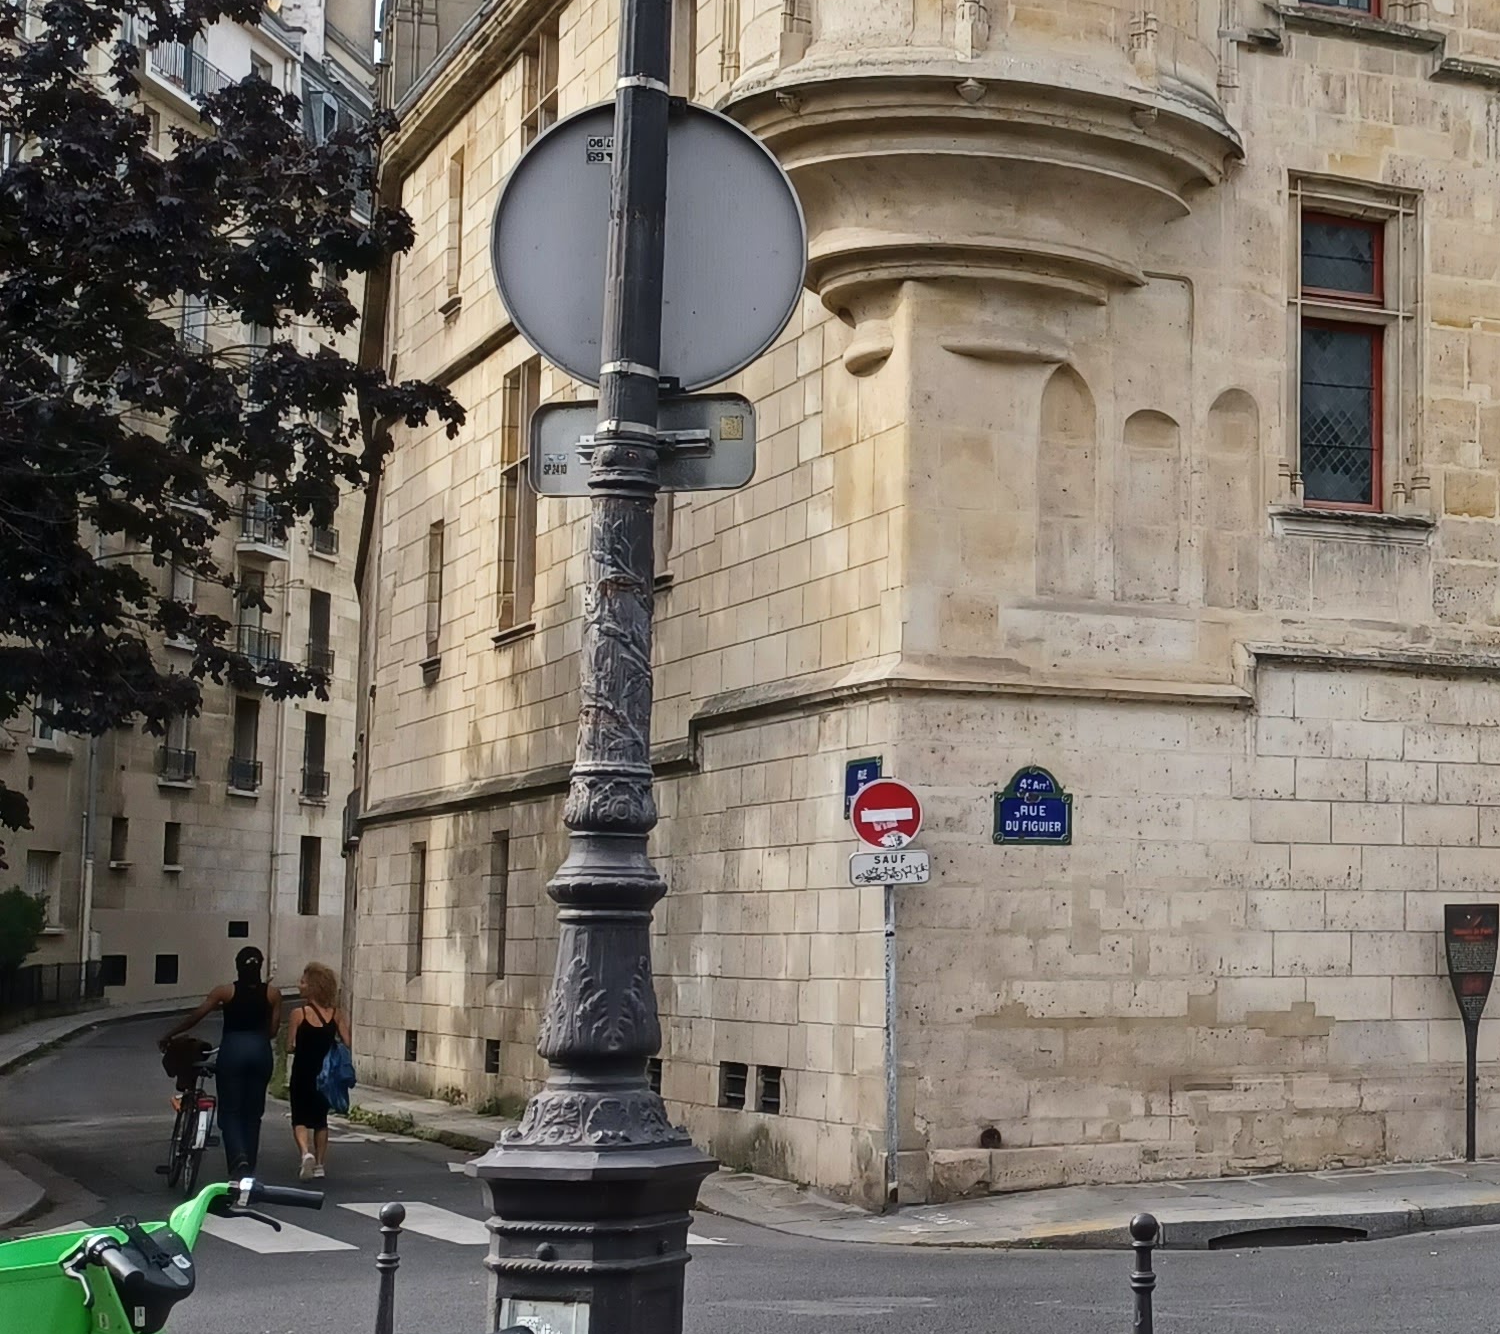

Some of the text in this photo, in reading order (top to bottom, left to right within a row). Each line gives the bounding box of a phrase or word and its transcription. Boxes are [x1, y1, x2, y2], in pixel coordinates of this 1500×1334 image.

[1020, 805, 1047, 816] RUE
[1005, 820, 1062, 832] DU FIGUIER
[874, 854, 906, 865] SAUF
